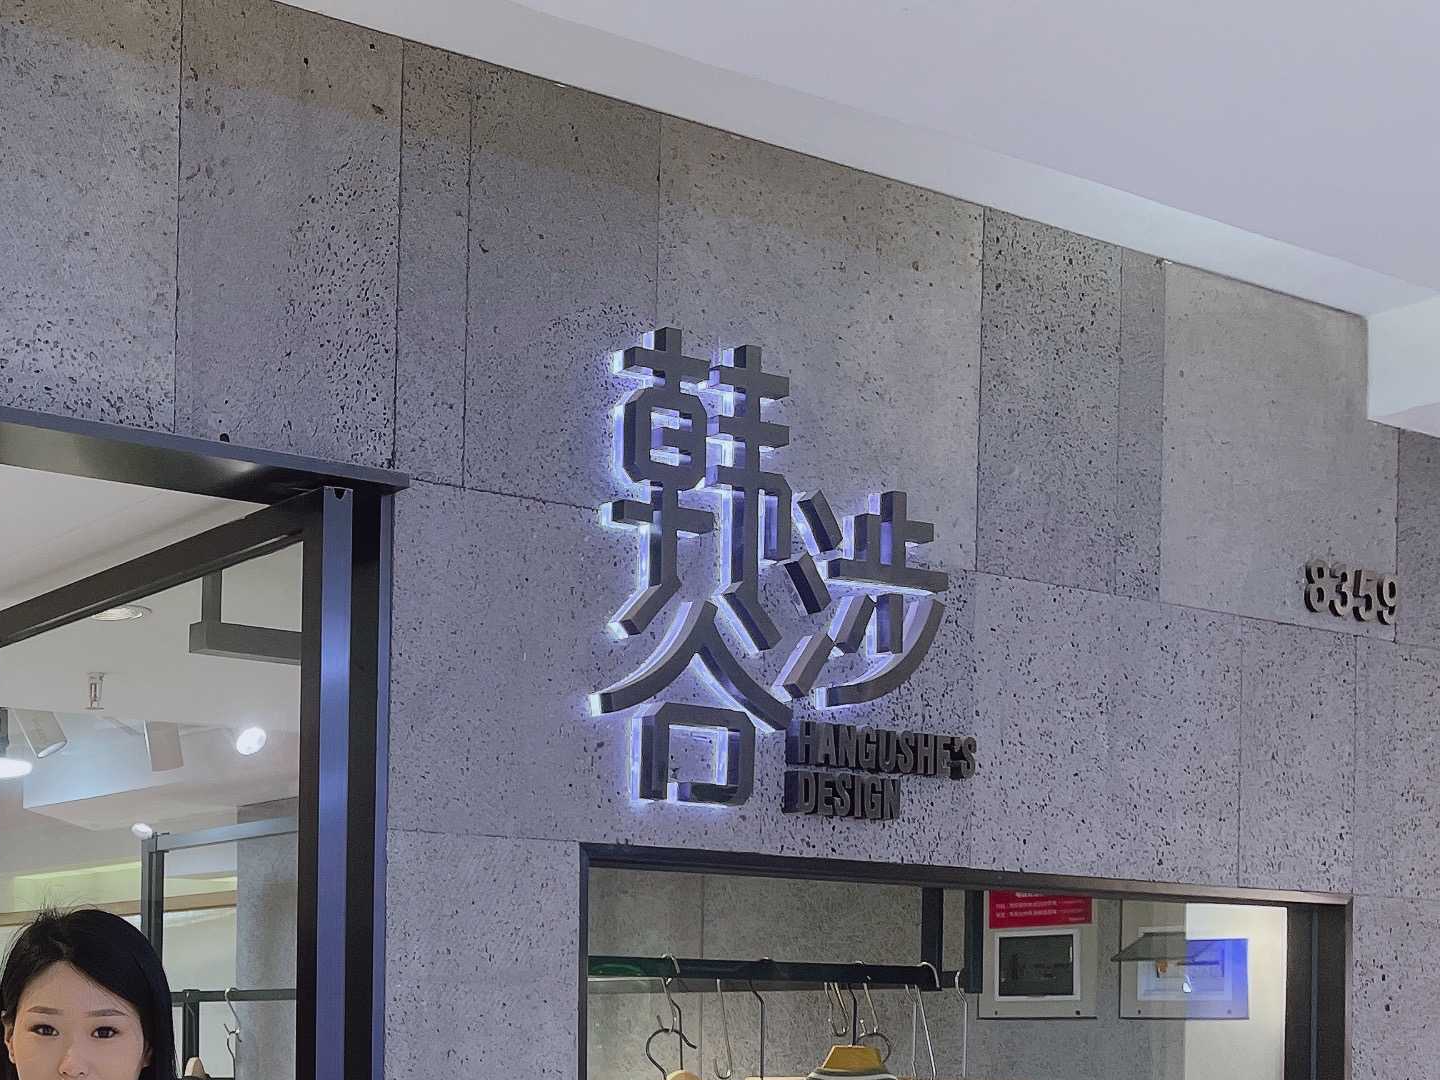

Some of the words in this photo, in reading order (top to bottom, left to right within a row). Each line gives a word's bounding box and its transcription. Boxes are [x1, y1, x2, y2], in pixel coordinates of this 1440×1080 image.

[1305, 559, 1399, 625] 8359
[793, 720, 977, 779] HANGUSHE'S
[793, 772, 901, 820] DESIGN
